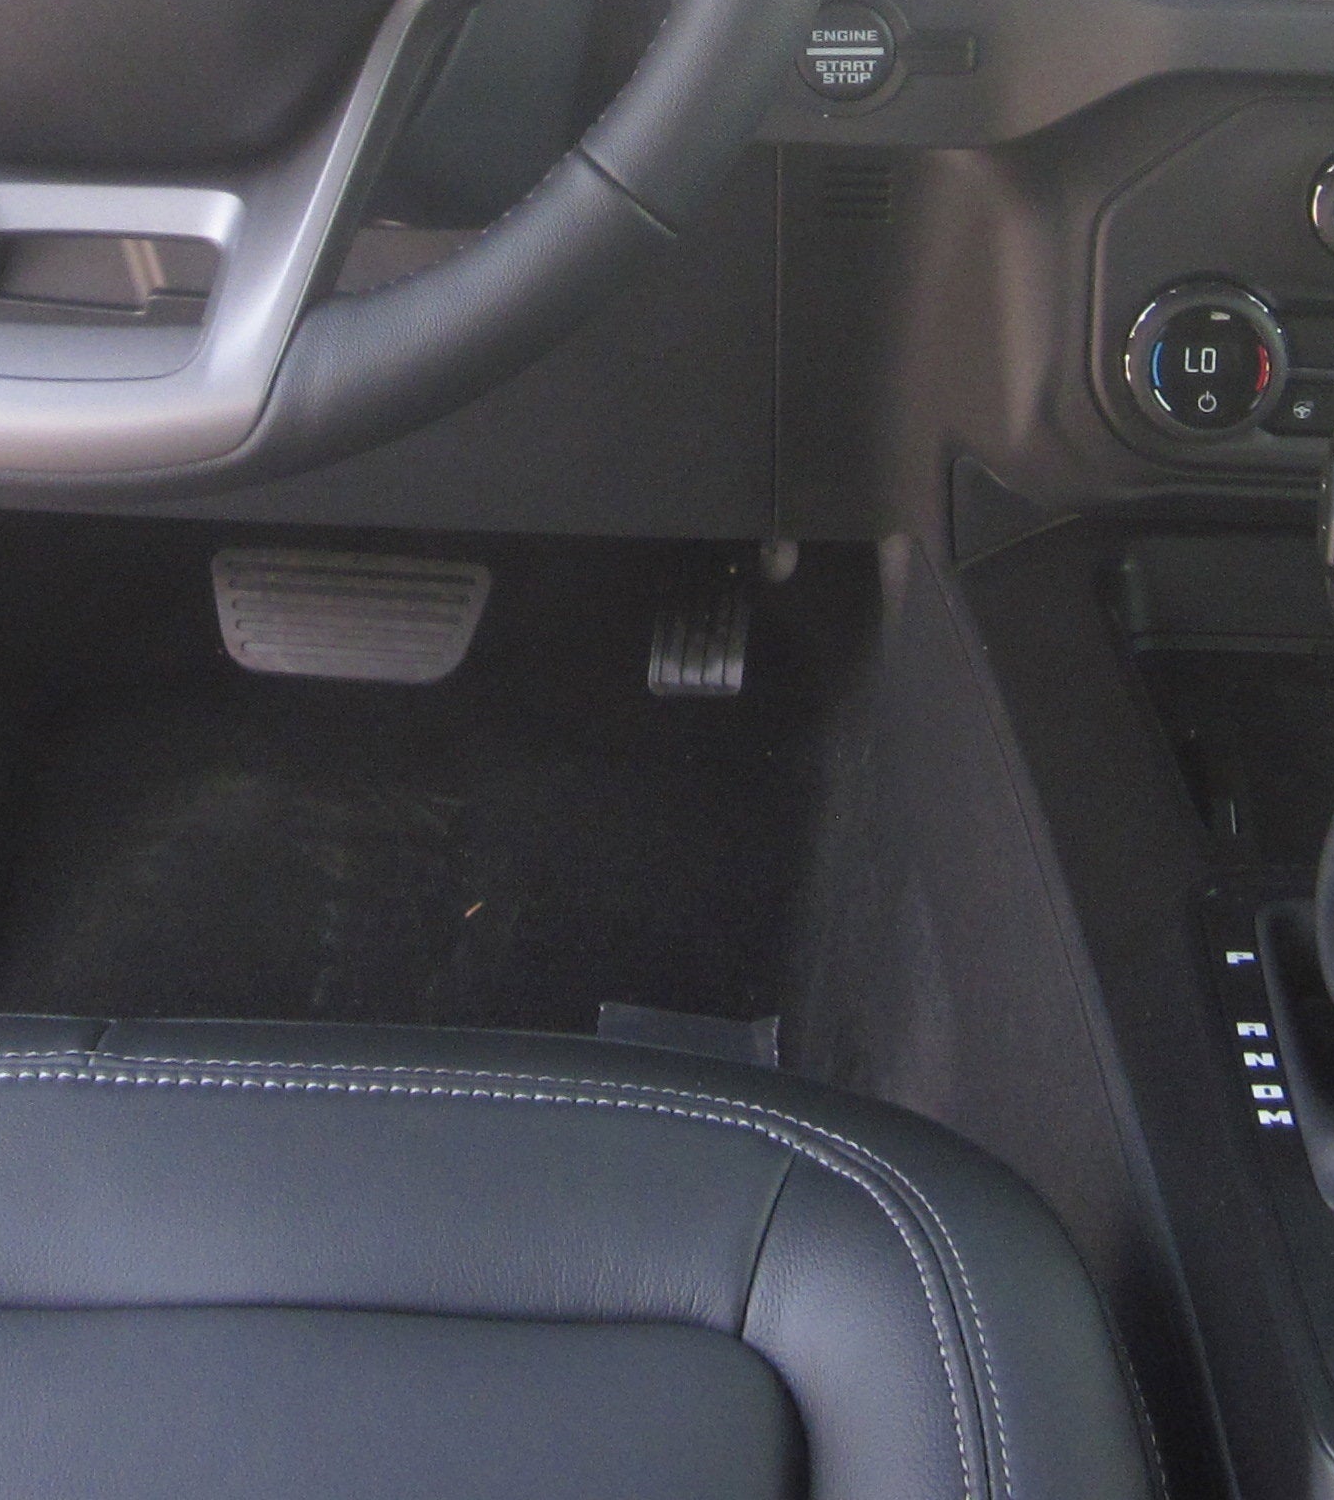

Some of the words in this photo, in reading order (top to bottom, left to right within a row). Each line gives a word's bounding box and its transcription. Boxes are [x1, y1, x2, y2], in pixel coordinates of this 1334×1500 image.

[811, 30, 879, 42] ENGINE
[815, 60, 877, 72] START
[822, 72, 872, 85] STOP
[1225, 951, 1255, 965] P
[1243, 1052, 1276, 1067] N
[1251, 1084, 1285, 1100] D
[1257, 1109, 1294, 1126] M
